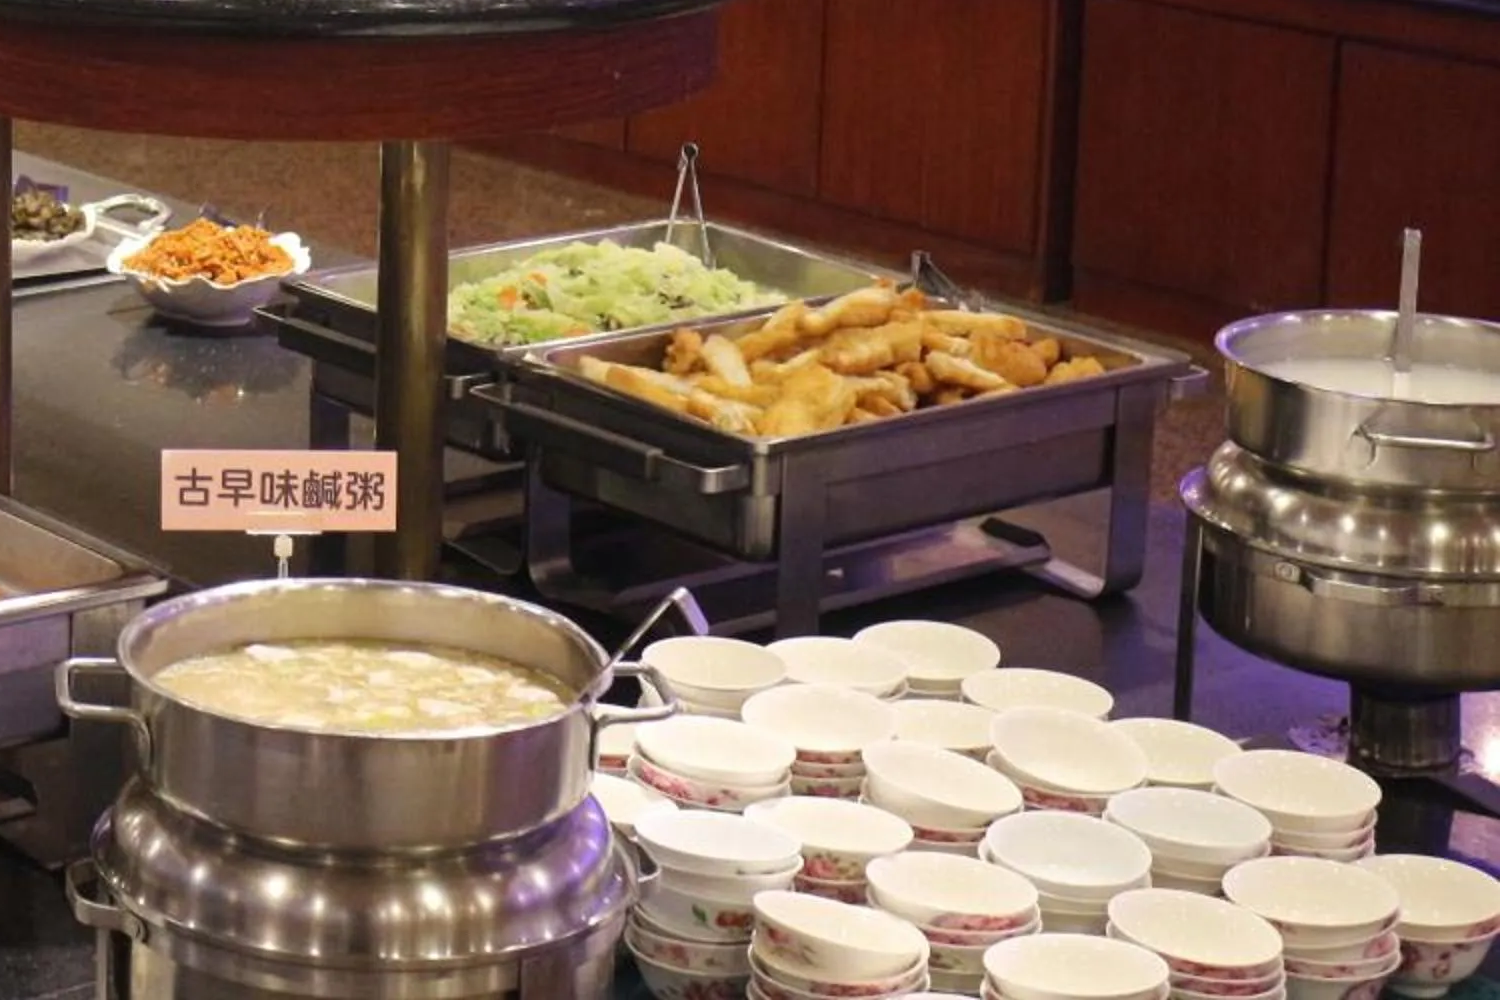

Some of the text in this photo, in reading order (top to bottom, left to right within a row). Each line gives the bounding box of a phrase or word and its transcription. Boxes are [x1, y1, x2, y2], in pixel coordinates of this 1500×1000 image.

[174, 467, 385, 510] 古早味鹹粥
